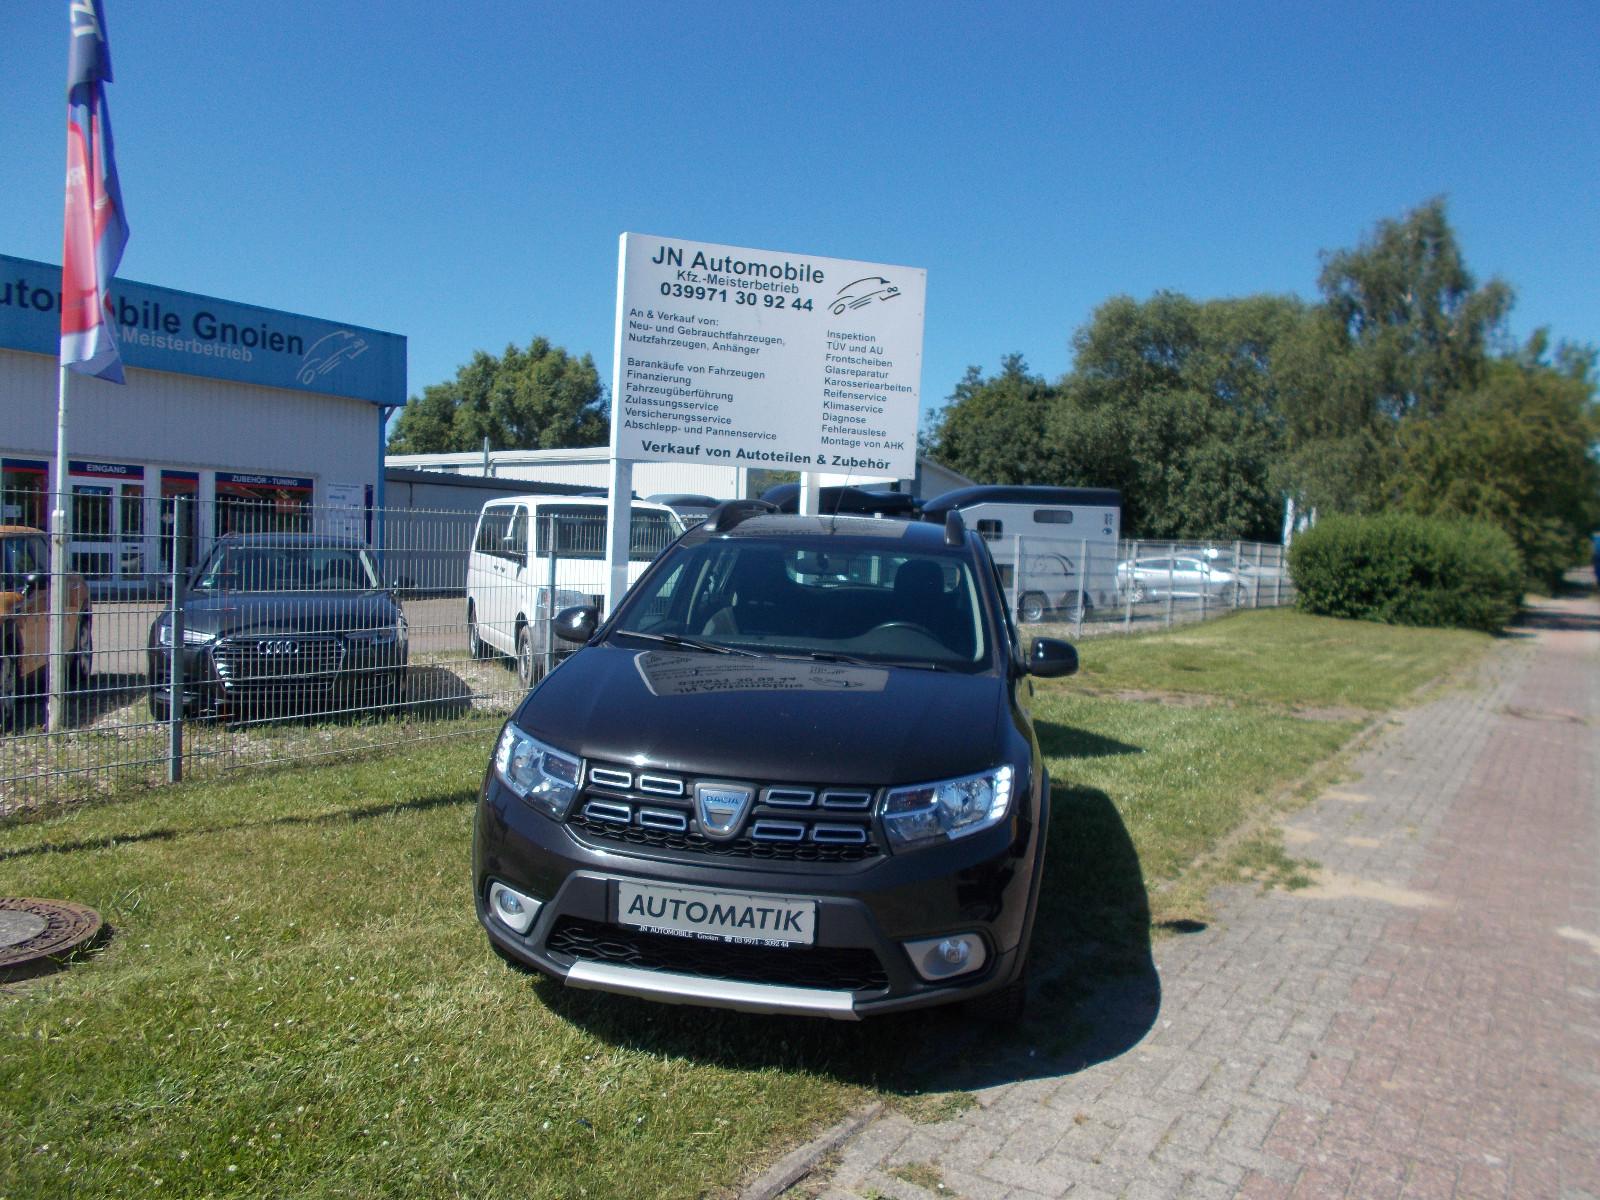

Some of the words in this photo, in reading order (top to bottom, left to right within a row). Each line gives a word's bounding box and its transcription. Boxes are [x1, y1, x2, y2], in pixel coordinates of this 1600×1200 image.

[652, 246, 683, 267] JN
[691, 251, 824, 283] Automobile
[677, 269, 800, 294] Kfz.-Meisterbetrieb
[660, 281, 727, 303] 039971
[735, 290, 757, 306] 30
[763, 294, 785, 309] 92
[791, 297, 814, 312] 44
[629, 308, 644, 318] An
[646, 310, 654, 319] &
[657, 311, 695, 324] Verkauf
[193, 312, 304, 355] Gnoien
[629, 320, 653, 331] Neu-
[655, 323, 675, 334] und
[677, 326, 786, 345] Gebrauchtfahrzeugen,
[827, 330, 876, 342] Inspektion
[628, 333, 710, 351] Nutzfahrzeugen,
[712, 342, 760, 355] Anhänger
[826, 340, 846, 351] TÜV
[848, 345, 867, 354] und
[869, 346, 884, 355] AU
[825, 353, 893, 367] Frontscheiben
[627, 357, 685, 372] Barankäufe
[687, 365, 705, 374] von
[708, 366, 765, 380] Fahrzeugen
[825, 365, 889, 379] Glasreparatur
[626, 370, 692, 387] Finanzierung
[824, 377, 912, 393] Karosseriearbeiten
[626, 382, 734, 402] Fahrzeugüberführung
[823, 388, 887, 402] Reifenservice
[625, 394, 719, 411] Zulassungsservice
[823, 401, 884, 414] Klimaservice
[625, 407, 732, 425] Versicherungsservice
[822, 412, 867, 424] Diagnose
[624, 419, 681, 434] Abschlepp-
[684, 426, 703, 435] und
[705, 427, 777, 441] Pannenservice
[821, 424, 887, 437] Fehlerauslese
[820, 436, 861, 449] Montage
[863, 441, 880, 449] von
[883, 441, 904, 450] AHK
[641, 440, 701, 456] Verkauf
[706, 447, 731, 458] von
[735, 448, 811, 464] Autoteilen
[816, 454, 826, 465] &
[831, 455, 891, 470] Zubehör
[86, 463, 127, 475] EINGANG
[231, 474, 267, 485] ZUBEHÖR
[627, 894, 804, 933] AUTOMATIK
[650, 926, 693, 938] AUTOMOBILE
